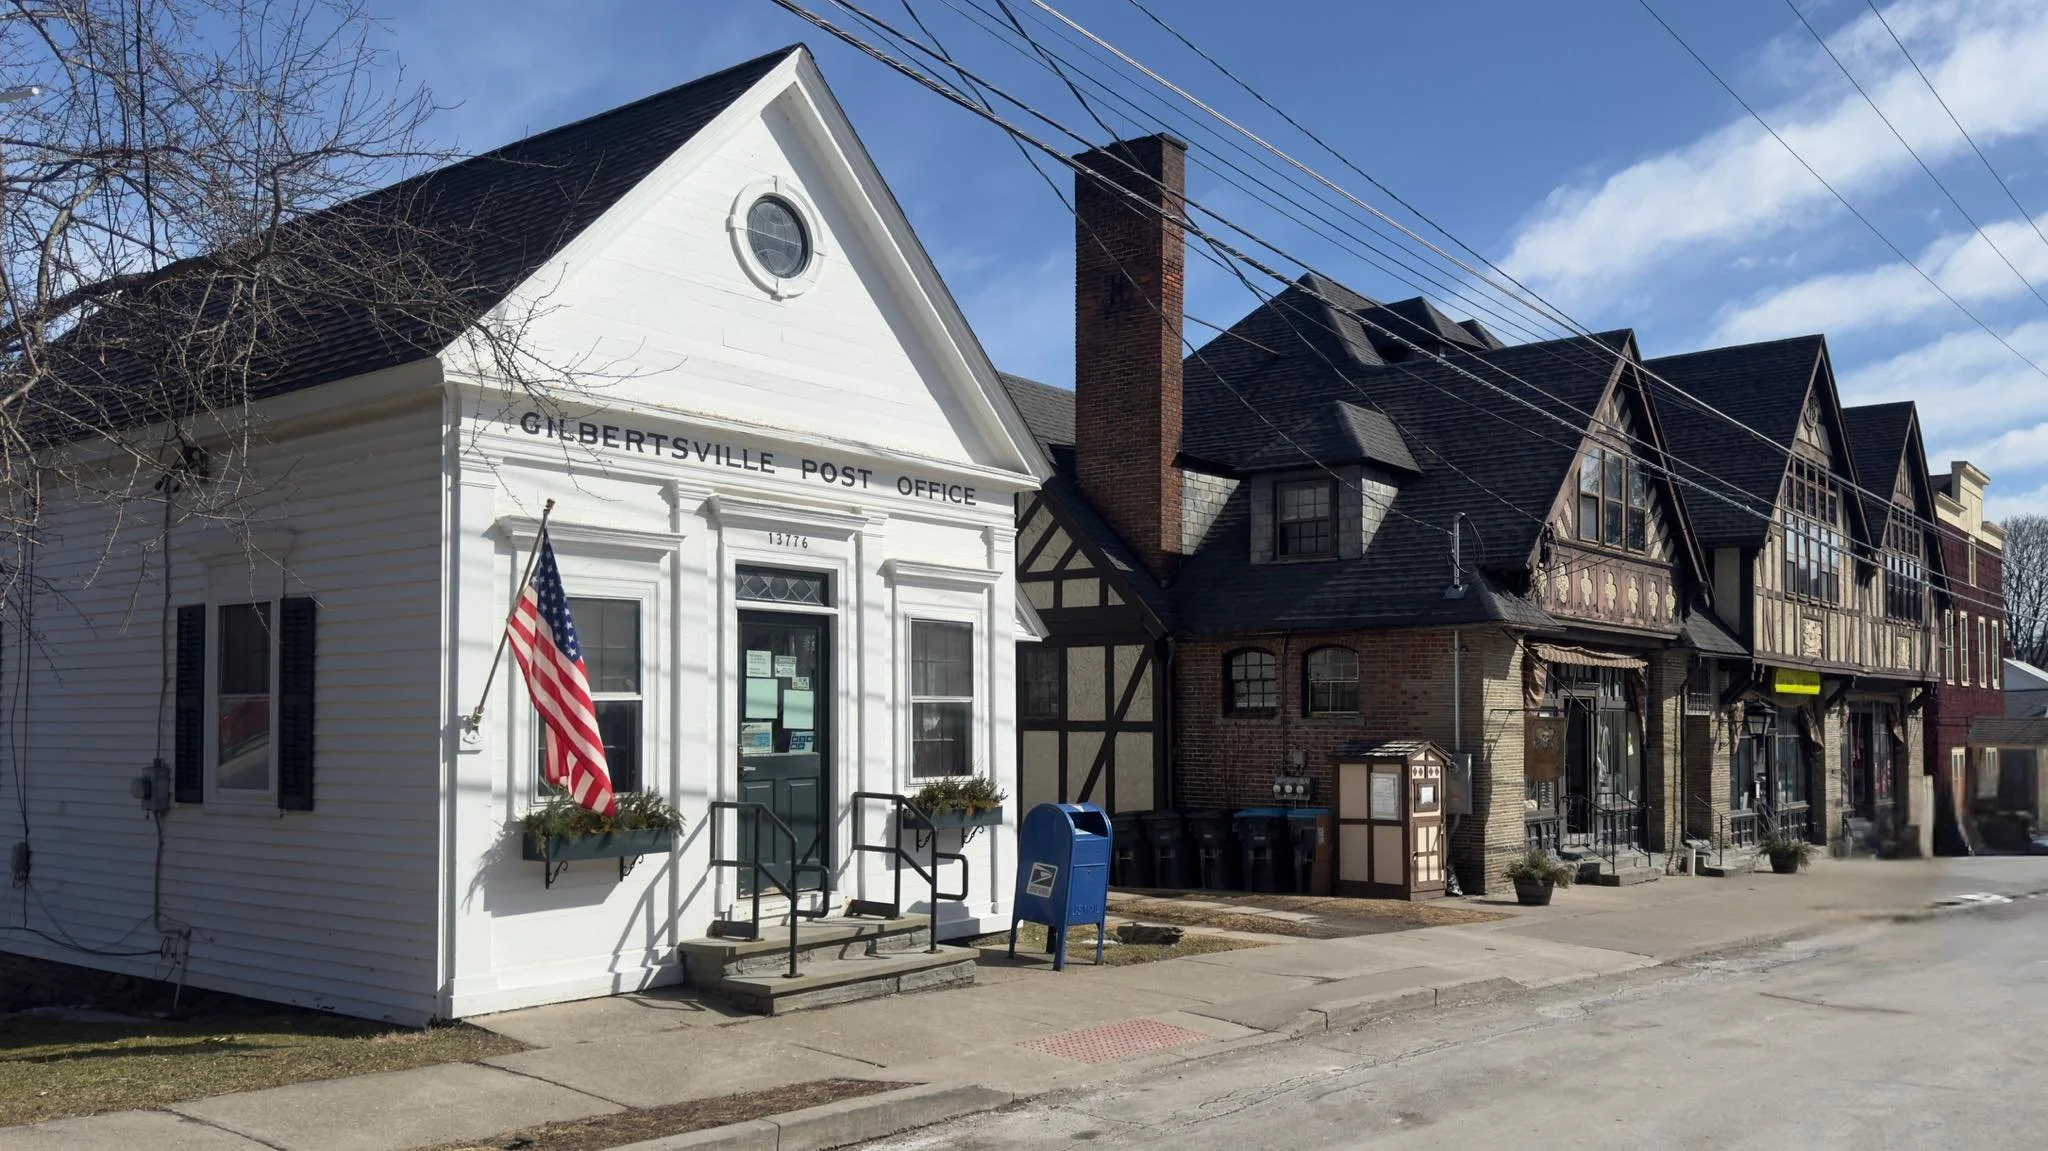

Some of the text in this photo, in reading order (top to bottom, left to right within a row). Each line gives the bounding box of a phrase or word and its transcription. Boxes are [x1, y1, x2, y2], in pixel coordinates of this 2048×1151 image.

[520, 411, 977, 506] GILBERTSVILLE POST OFFICE
[769, 532, 808, 549] 13776
